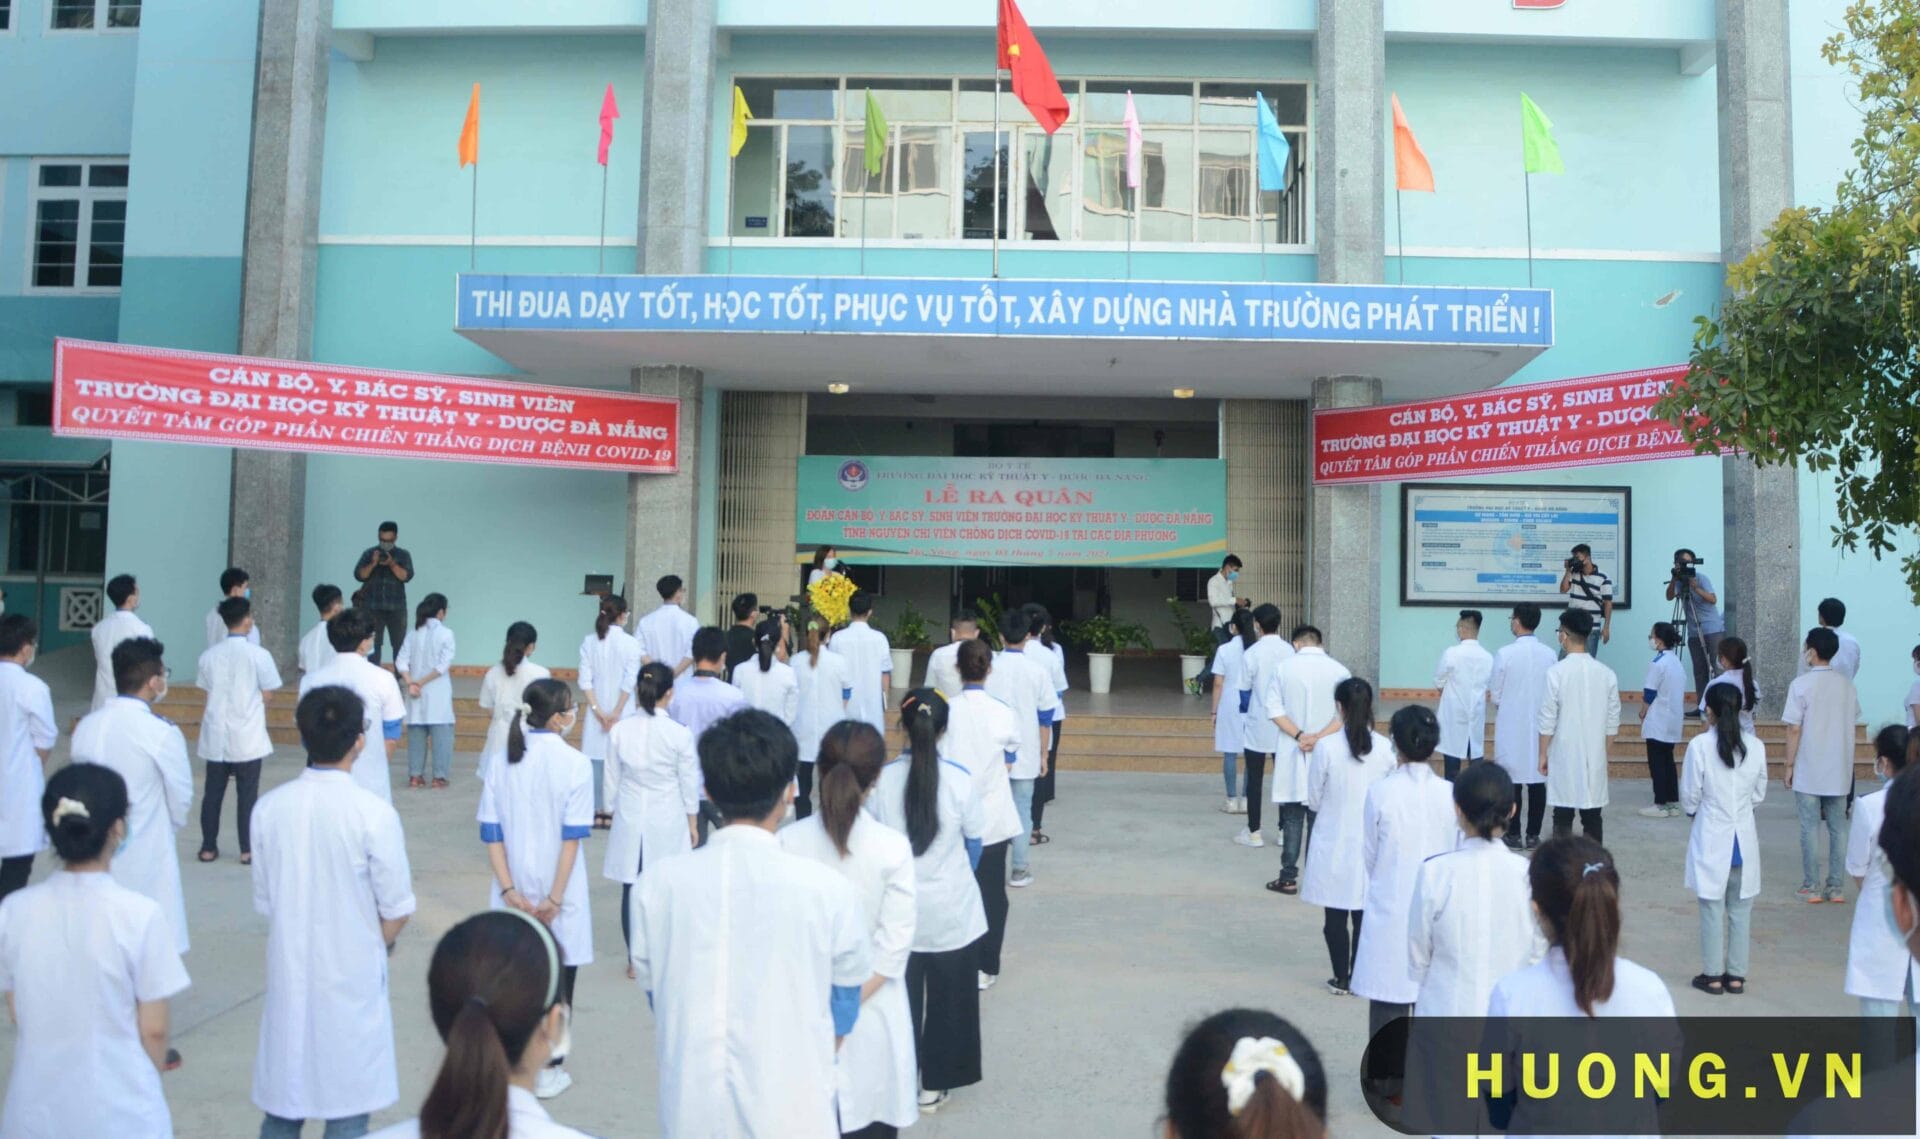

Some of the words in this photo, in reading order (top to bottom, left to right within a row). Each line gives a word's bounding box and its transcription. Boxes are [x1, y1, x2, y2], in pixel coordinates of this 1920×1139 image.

[472, 290, 512, 317] THI
[519, 290, 572, 318] ĐUA
[580, 291, 631, 323] DẠY
[639, 282, 698, 324] TỐT,
[704, 291, 761, 324] HỌC
[768, 283, 826, 326] TỐT,
[834, 293, 908, 327] PHỤC
[916, 294, 954, 327] VỤ
[960, 284, 1021, 329] TỐT,
[1028, 289, 1083, 325] XÂY
[1093, 292, 1172, 332] DỰNG
[1179, 290, 1237, 327] NHÀ
[1244, 291, 1361, 329] TRƯỜNG
[1367, 294, 1439, 332] PHÁT
[74, 379, 202, 405] TRƯỜNG
[209, 391, 260, 412] ĐẠI
[268, 397, 329, 416] HỌC
[333, 400, 367, 418] KỸ
[376, 404, 458, 427] THUẬT
[465, 413, 482, 427] Y
[499, 415, 566, 435] DƯỢC
[570, 418, 602, 436] ĐÀ
[607, 419, 669, 441] NẴNG
[209, 366, 270, 387] CÁN
[277, 372, 320, 394] BỘ,
[328, 378, 347, 395] Y,
[355, 379, 408, 399] BÁC
[414, 386, 452, 405] SỸ,
[459, 392, 515, 408] SINH
[521, 394, 576, 413] VIÊN
[1389, 409, 1426, 427] CÁN
[1430, 406, 1458, 424] BỘ,
[1462, 403, 1478, 419] Y,
[1482, 398, 1521, 417] BÁC
[1526, 392, 1557, 412] SỸ,
[1562, 387, 1614, 408] SINH
[1619, 378, 1674, 400] VIÊN
[71, 404, 157, 427] QUYẾT
[163, 410, 212, 431] TÂM
[219, 415, 267, 435] GÓP
[272, 418, 335, 442] PHẦN
[341, 425, 409, 444] CHIẾN
[414, 428, 482, 450] THẮNG
[488, 437, 535, 455] DỊCH
[540, 439, 592, 457] BỆNH
[596, 445, 672, 462] COVID-19
[1320, 454, 1362, 475] QUYẾT
[1364, 455, 1392, 471] TÂM
[1395, 450, 1424, 469] GÓP
[1426, 445, 1467, 466] PHẦN
[1471, 441, 1521, 462] CHIẾN
[1524, 434, 1583, 458] THẮNG
[1586, 434, 1631, 453] DỊCH
[1321, 433, 1386, 453] TRƯỜNG
[1390, 431, 1420, 448] ĐẠI
[1424, 426, 1463, 446] HỌC
[1467, 422, 1493, 440] KỸ
[1497, 414, 1562, 439] THUẬT
[1567, 414, 1582, 430] Y
[925, 481, 958, 503] LỄ
[969, 490, 1005, 504] RA
[1014, 486, 1094, 507] QUÂN
